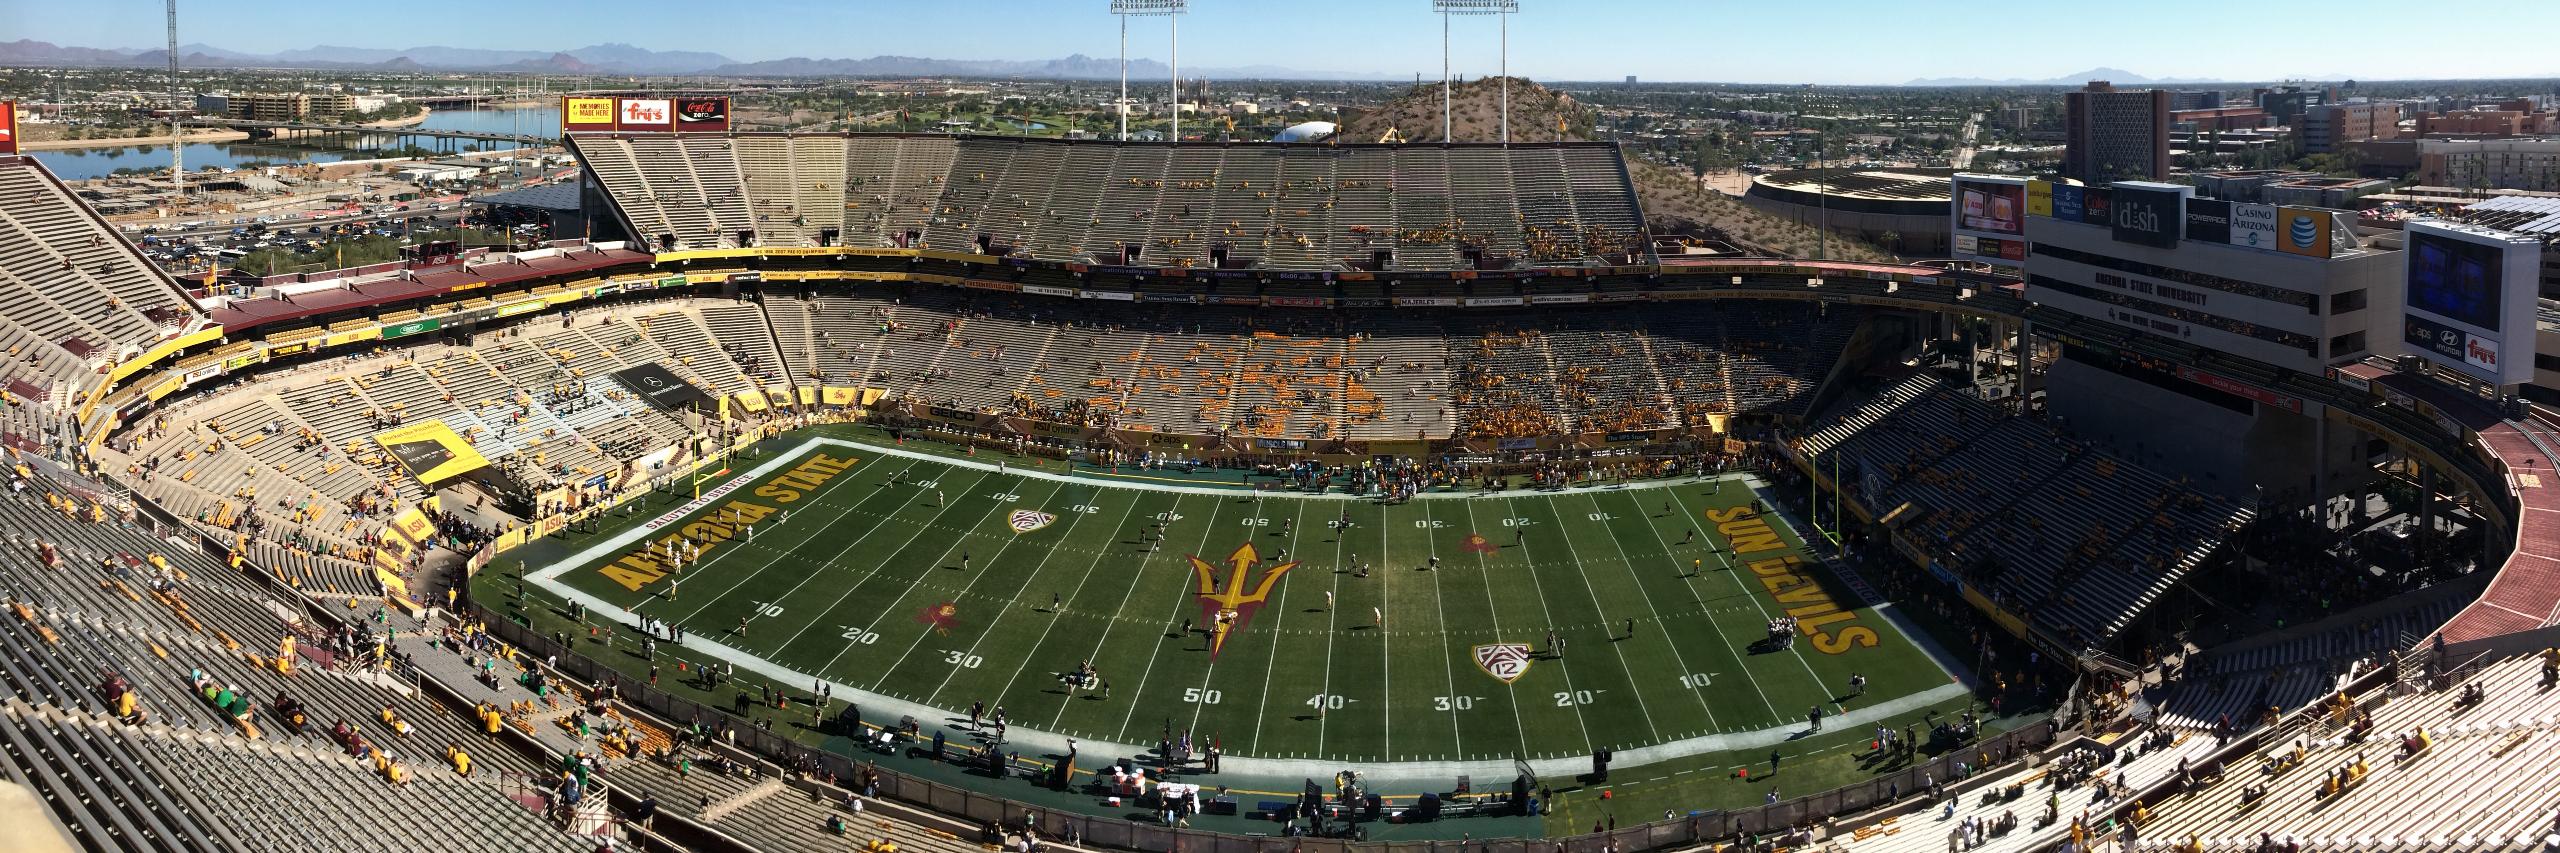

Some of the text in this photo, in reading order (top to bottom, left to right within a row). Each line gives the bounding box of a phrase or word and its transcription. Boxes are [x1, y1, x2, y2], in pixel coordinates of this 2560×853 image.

[2085, 194, 2110, 208] Coke
[2088, 208, 2106, 217] zero
[2119, 202, 2160, 233] dish
[2187, 213, 2227, 225] POWERADE
[2236, 205, 2272, 220] CASINO
[2232, 219, 2276, 233] ARIZONA
[432, 256, 448, 266] ASU
[2130, 279, 2153, 294] STATE
[2156, 285, 2207, 306] UNIVERSITY
[2416, 327, 2432, 340] aps
[2436, 344, 2462, 357] HYUNDAI
[2467, 339, 2496, 364] fry's
[202, 367, 216, 377] online
[930, 405, 976, 422] GEICO
[1034, 421, 1079, 435] ASU online
[1164, 436, 1181, 445] aps
[1256, 438, 1306, 450] MUSCLE MILK
[1608, 432, 1647, 442] The UPS Store
[970, 438, 1061, 458] THESUNDELS.COM
[1728, 441, 1744, 452] ASU
[754, 453, 860, 503] STATE
[917, 479, 938, 489] 10
[646, 506, 692, 530] SALUTE
[710, 475, 754, 497] SERVICE
[992, 492, 1021, 503] 20
[1072, 504, 1100, 514] 30
[545, 516, 563, 532] ASU
[1241, 517, 1269, 527] 50
[1502, 517, 1531, 527] 20
[1588, 512, 1612, 522] 10
[407, 518, 425, 534] ASU
[1415, 520, 1444, 529] 30
[1705, 506, 1789, 554] SUN
[754, 602, 785, 618] 10
[1743, 554, 1881, 655] DEVILS
[840, 628, 880, 645] 20
[944, 650, 984, 670] 30
[1475, 643, 1532, 664] PAC
[1492, 664, 1518, 676] 12
[1679, 673, 1711, 691] 10
[1183, 688, 1222, 705] 50
[1306, 694, 1344, 711] 40
[1553, 689, 1594, 708] 20
[1435, 696, 1474, 712] 30
